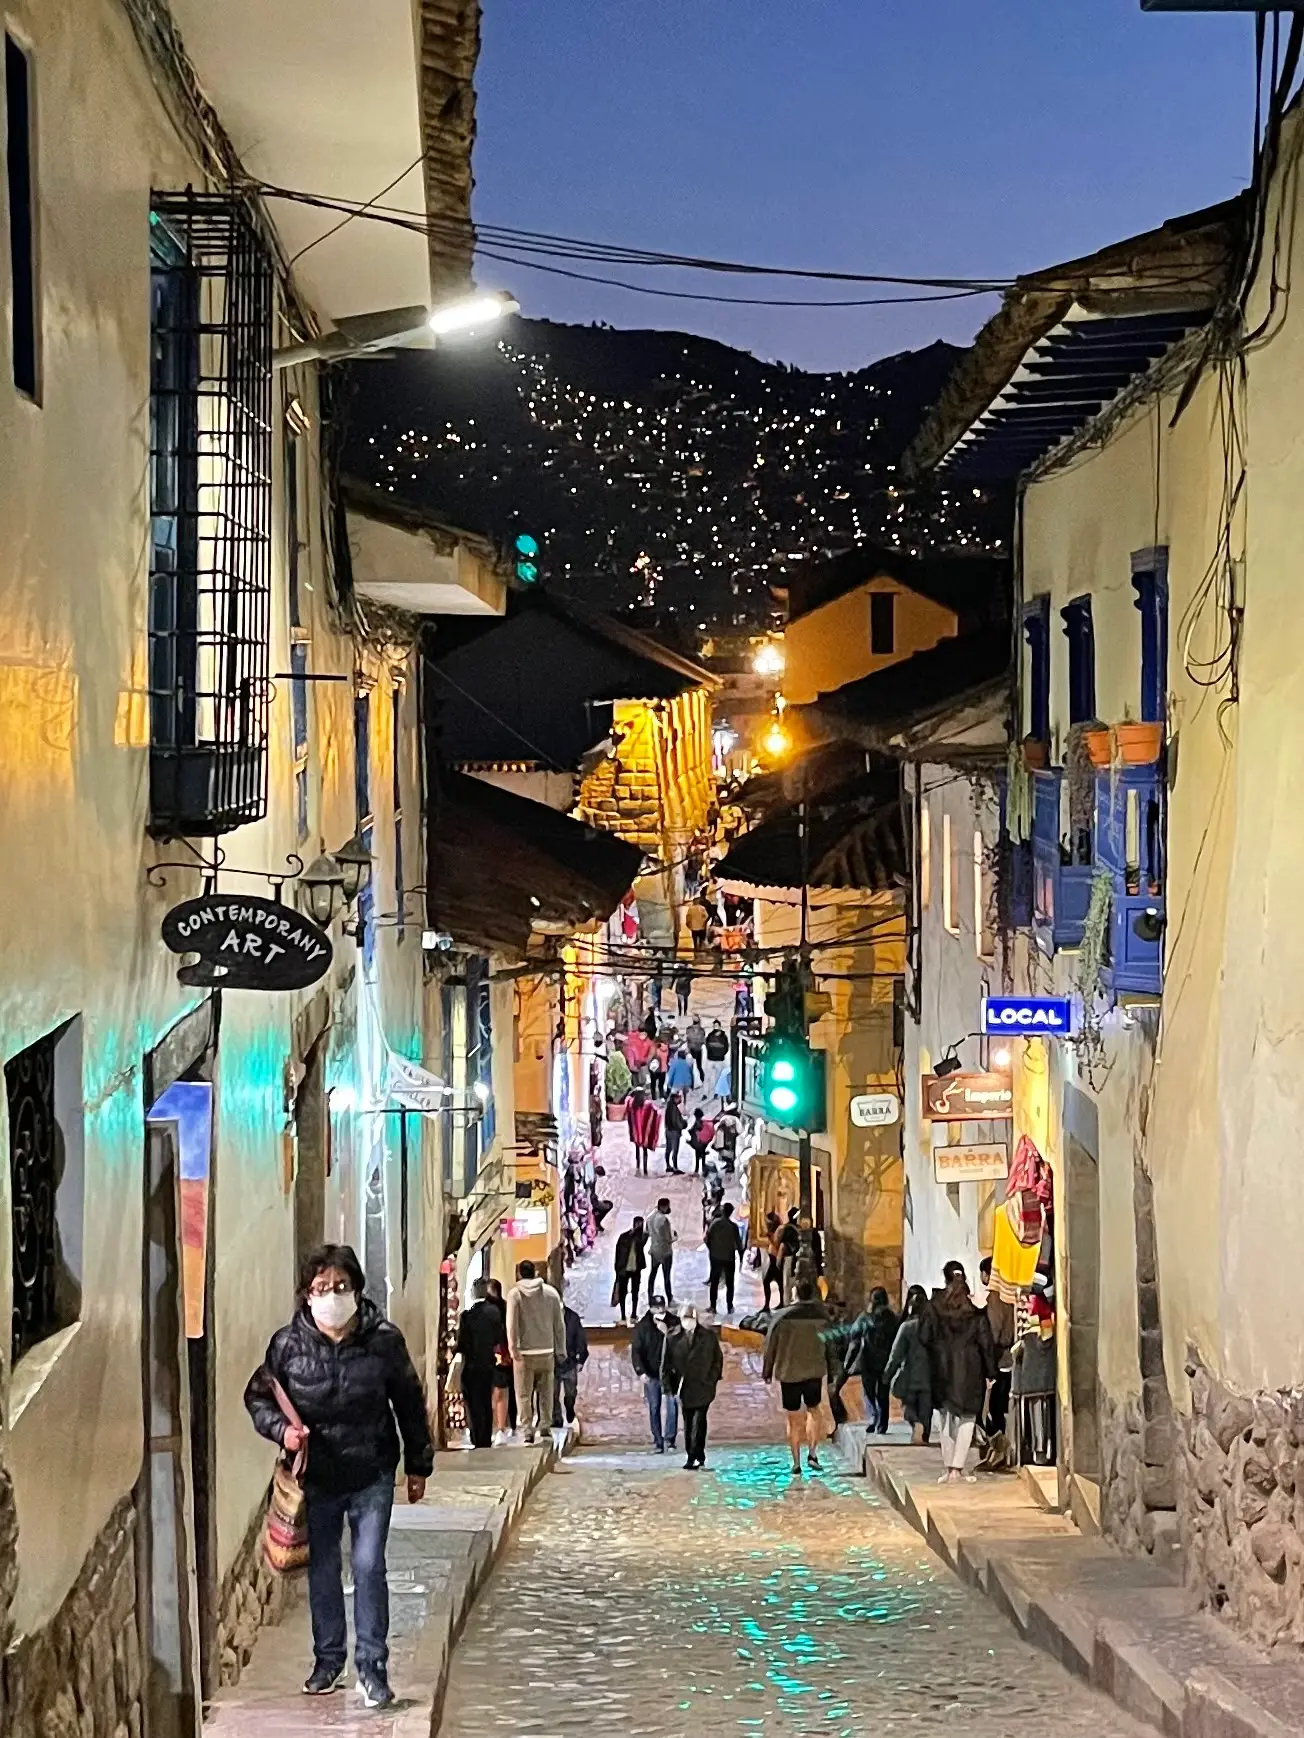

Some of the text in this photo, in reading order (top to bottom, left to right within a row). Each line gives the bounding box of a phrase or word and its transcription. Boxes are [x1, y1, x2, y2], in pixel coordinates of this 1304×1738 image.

[178, 904, 327, 961] CONTEMPORANY
[220, 929, 286, 964] ART
[988, 1008, 1063, 1025] LOCAL
[859, 1106, 891, 1116] BARRA
[938, 1152, 1004, 1169] BARRA
